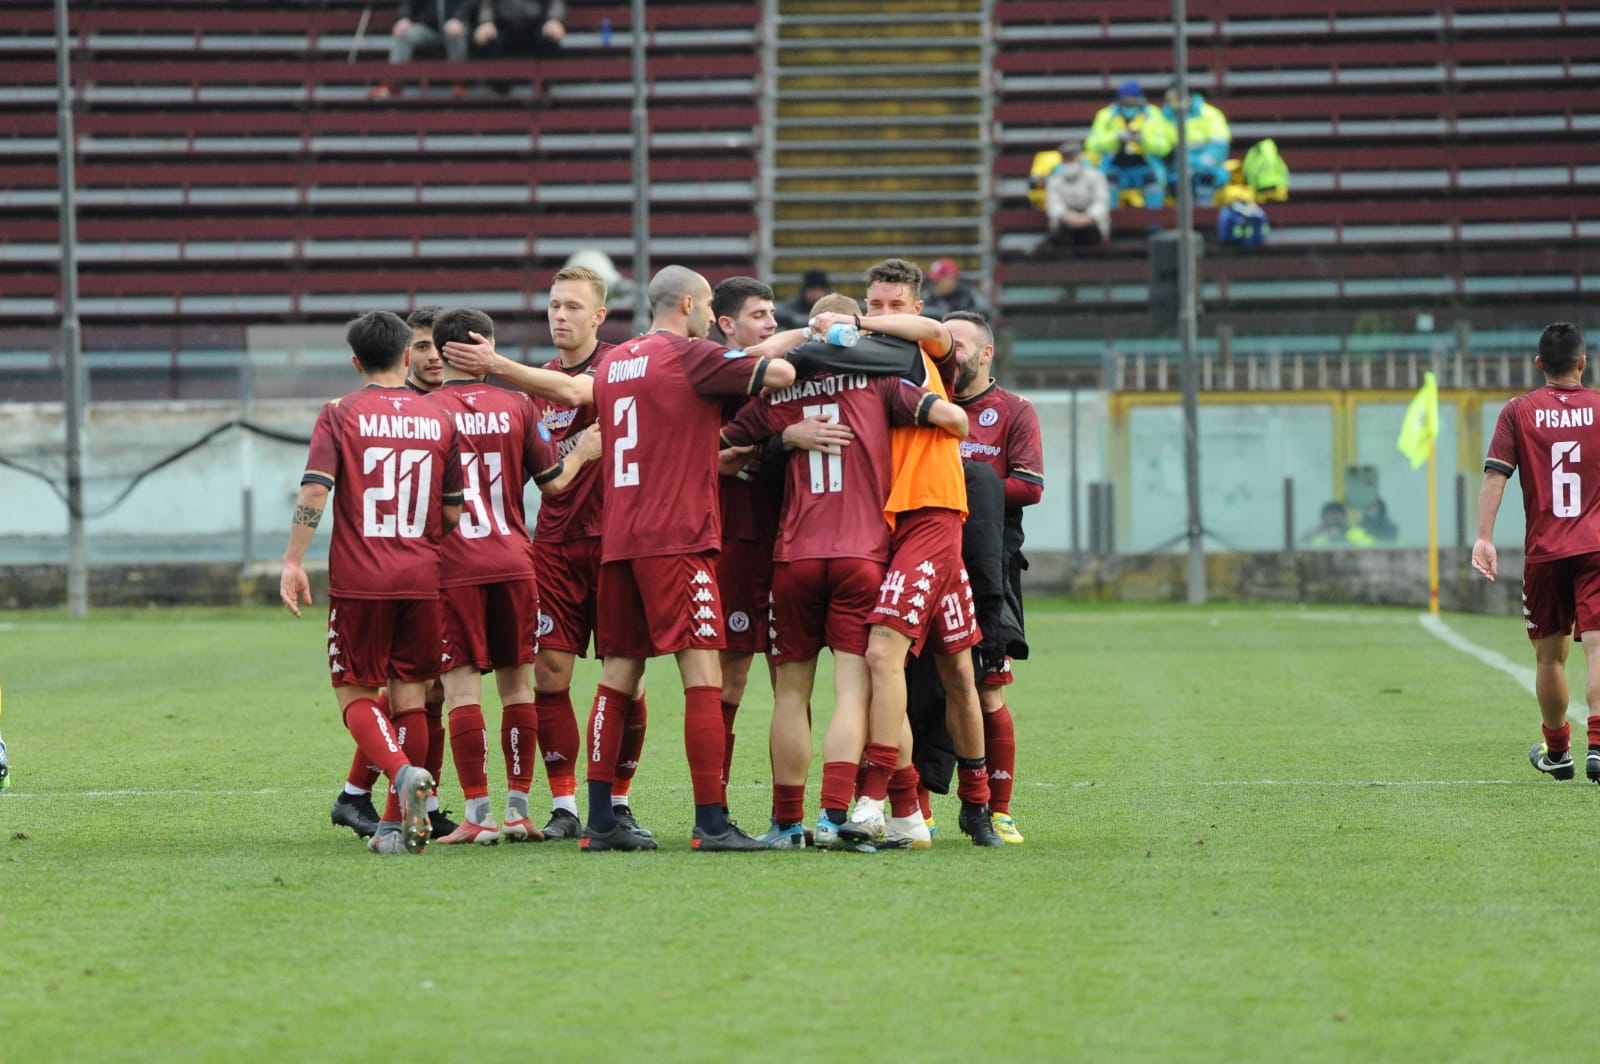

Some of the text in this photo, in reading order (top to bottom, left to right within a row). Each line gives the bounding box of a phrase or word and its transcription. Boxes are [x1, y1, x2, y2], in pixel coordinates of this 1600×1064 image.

[607, 355, 649, 384] BIONDI
[359, 413, 441, 441] MANCINO
[455, 411, 510, 435] ARRAS
[1535, 407, 1594, 428] PISANU
[613, 396, 640, 488] 2
[363, 447, 433, 538] 20
[459, 452, 512, 539] 31
[1551, 440, 1582, 518] 6
[941, 592, 965, 631] 21
